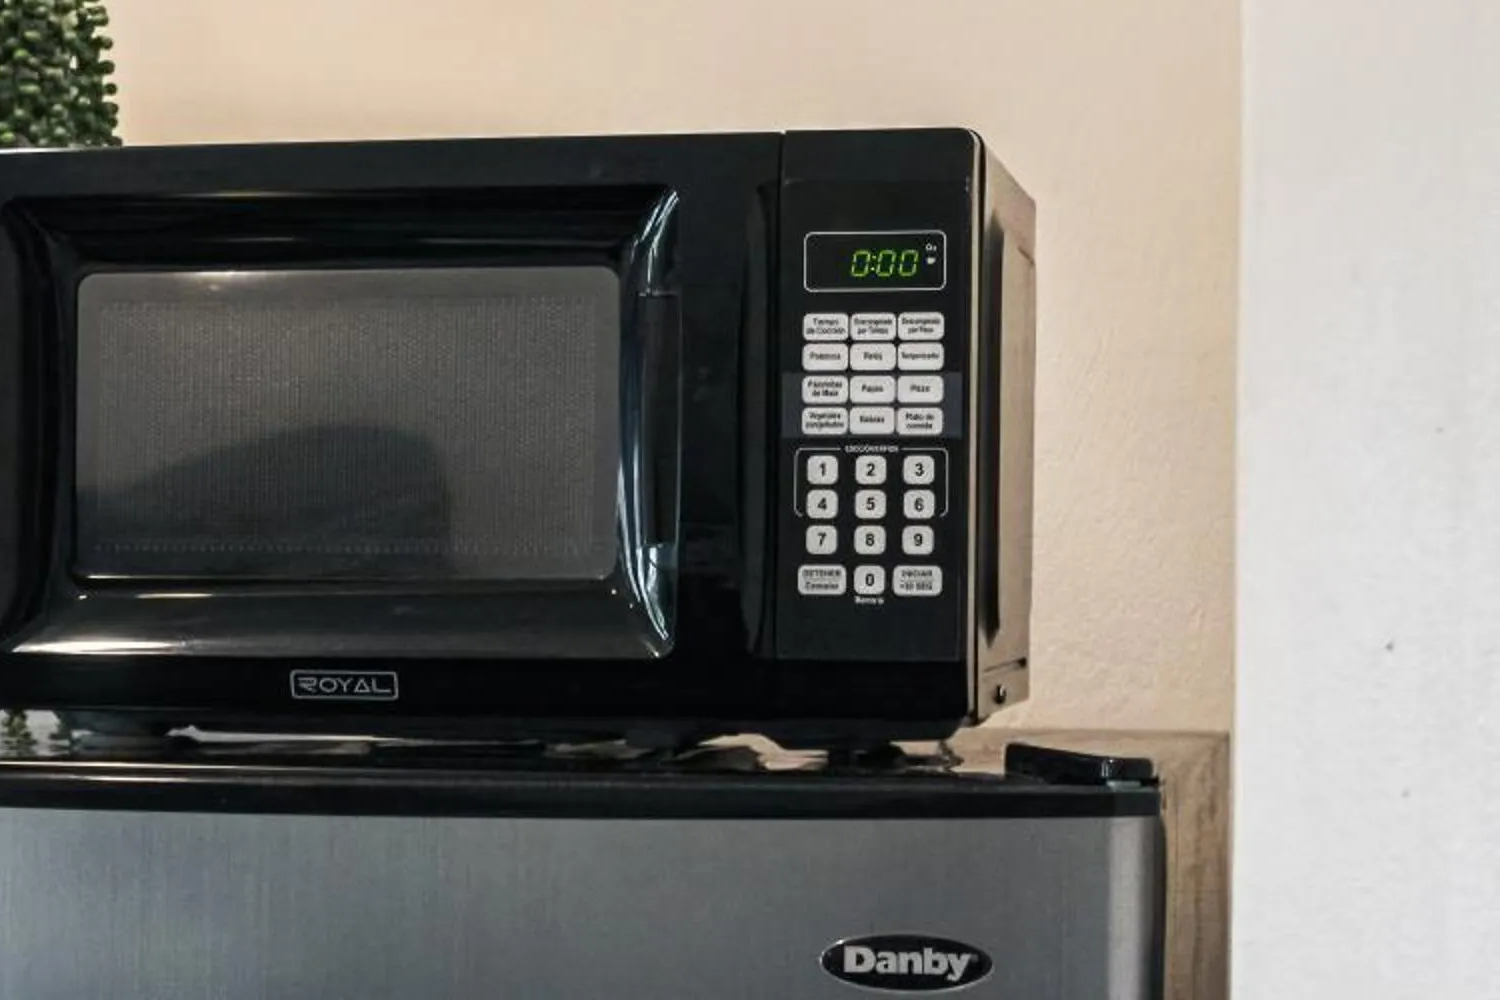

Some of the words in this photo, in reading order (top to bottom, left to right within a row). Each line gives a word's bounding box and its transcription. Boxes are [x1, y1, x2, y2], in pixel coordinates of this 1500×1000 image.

[851, 249, 919, 277] 0:00
[819, 462, 827, 477] 1
[866, 462, 876, 477] 2
[915, 462, 925, 477] 3
[817, 497, 827, 511] 4
[866, 497, 876, 511] 5
[914, 497, 925, 512] 6
[817, 532, 827, 547] 7
[865, 532, 875, 547] 8
[913, 532, 923, 547] 9
[865, 573, 875, 587] 0
[297, 676, 392, 693] ROYAL
[843, 944, 972, 981] Danby
